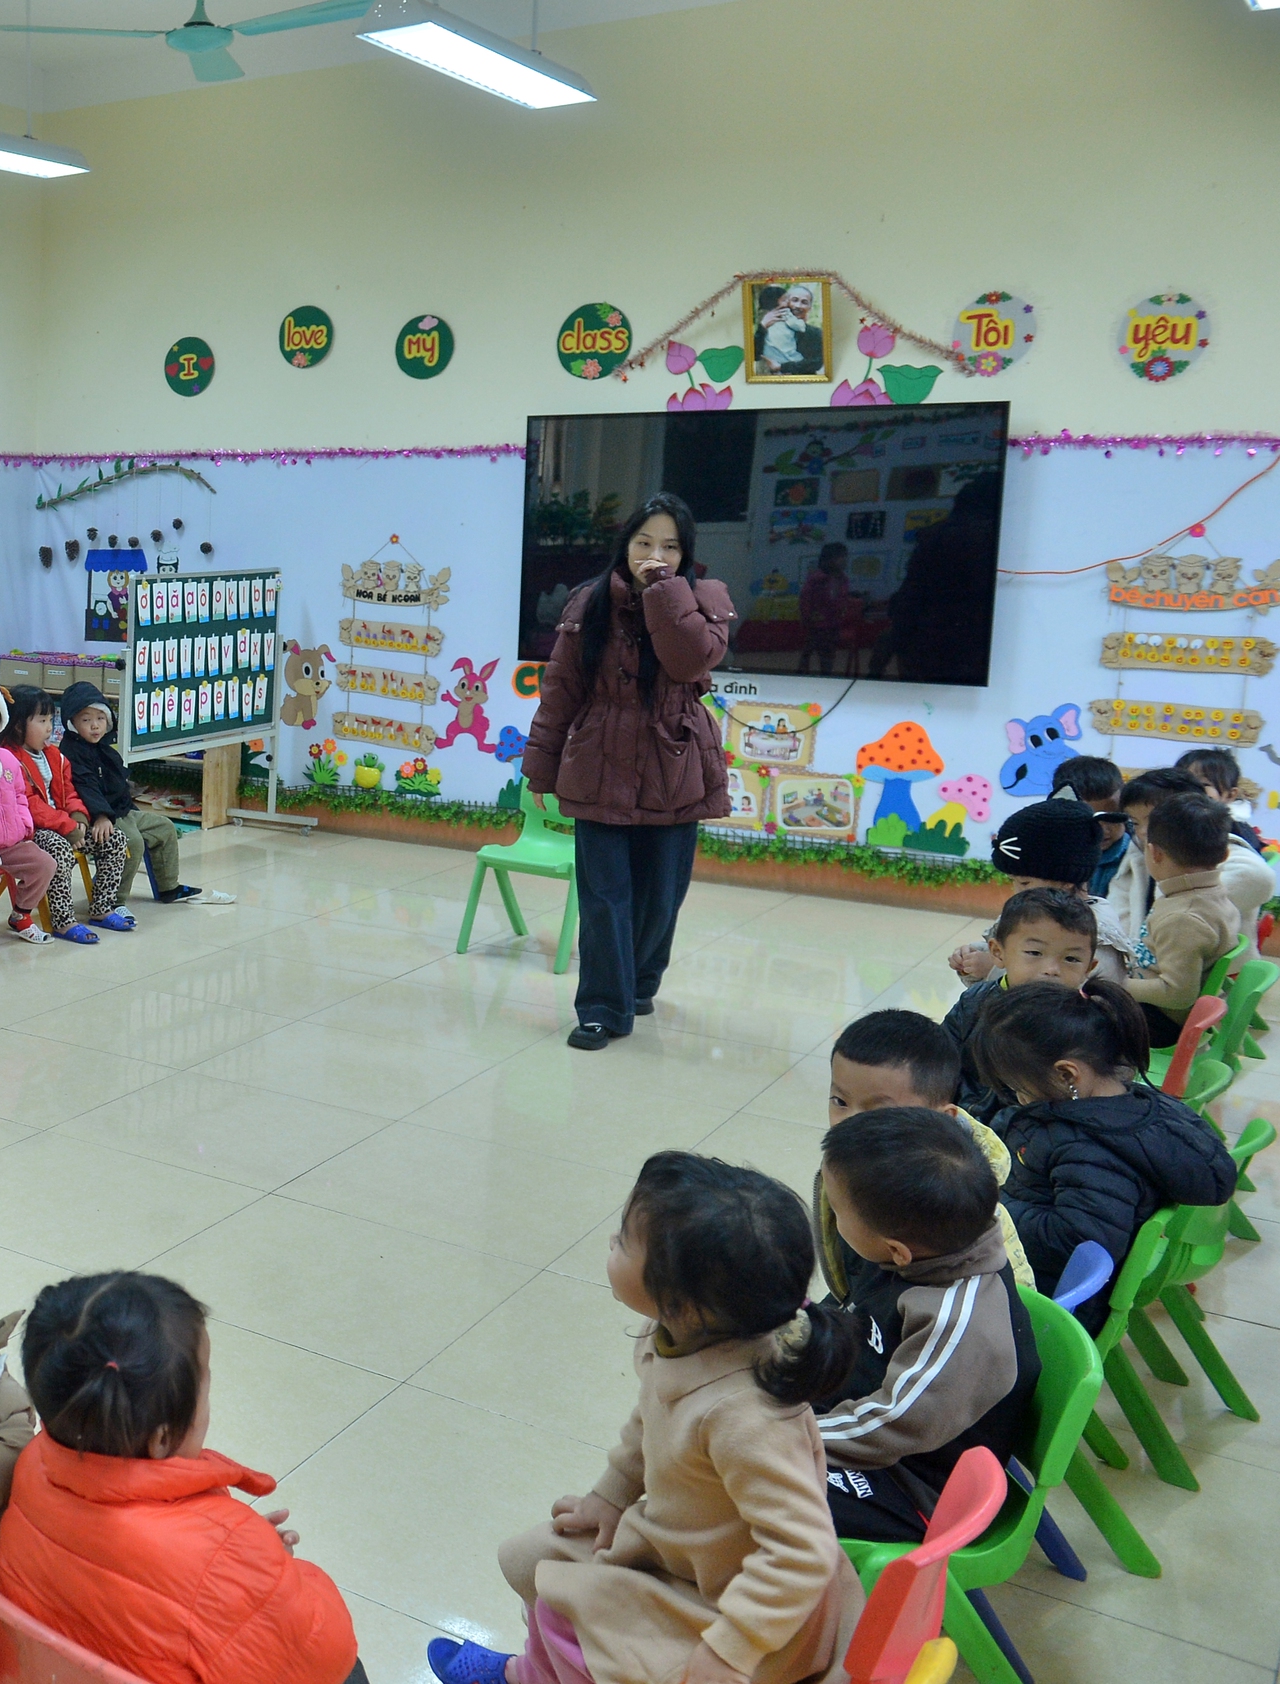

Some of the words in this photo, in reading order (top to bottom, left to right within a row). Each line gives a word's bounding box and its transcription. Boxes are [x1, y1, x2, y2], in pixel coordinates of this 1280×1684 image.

[181, 355, 197, 378] I
[286, 318, 325, 349] love
[561, 319, 627, 352] class
[965, 312, 1011, 348] Tôi
[1131, 315, 1194, 359] yêu
[140, 593, 148, 609] ơ
[155, 591, 164, 609] â
[170, 589, 179, 608] ă
[186, 591, 194, 605] a
[200, 588, 207, 607] ô
[214, 591, 222, 603] o
[228, 587, 234, 604] k
[253, 585, 260, 602] b
[266, 588, 275, 602] m
[1109, 585, 1141, 603] bé
[1140, 590, 1224, 611] chuyên
[138, 646, 147, 665] đ
[154, 651, 161, 664] u
[167, 647, 176, 663] ư
[197, 646, 203, 660] r
[210, 643, 216, 660] h
[223, 645, 230, 658] v
[239, 636, 247, 653] d
[252, 641, 259, 655] x
[266, 639, 273, 656] y
[724, 681, 757, 695] đình
[137, 700, 145, 720] g
[152, 702, 159, 716] n
[166, 694, 175, 712] ê
[183, 698, 192, 715] q
[200, 691, 208, 709] p
[216, 691, 223, 704] e
[244, 692, 250, 706] c
[257, 687, 263, 699] s
